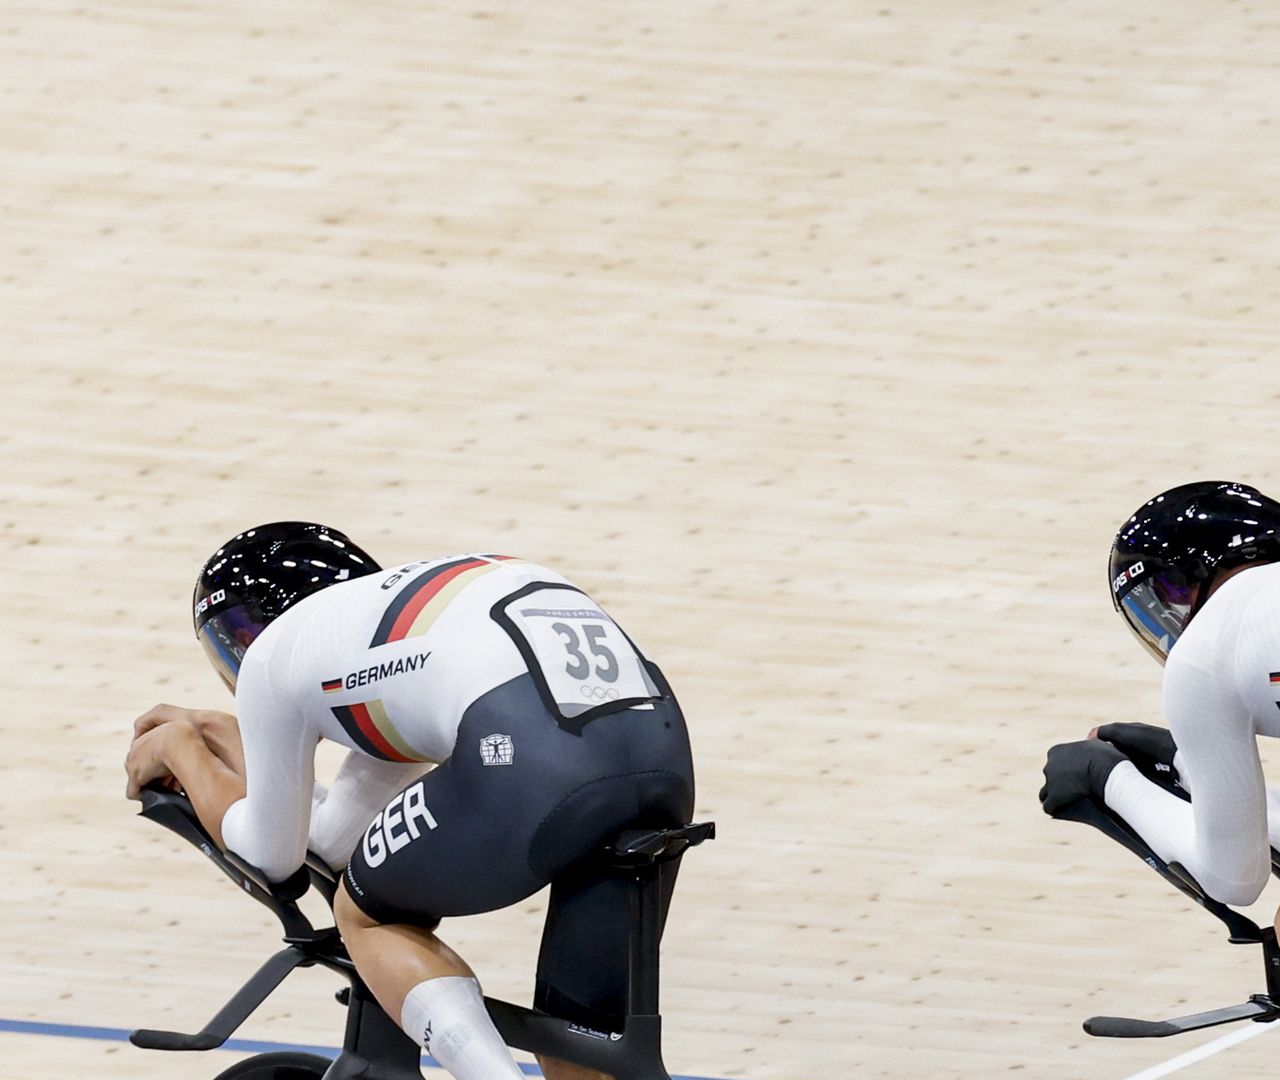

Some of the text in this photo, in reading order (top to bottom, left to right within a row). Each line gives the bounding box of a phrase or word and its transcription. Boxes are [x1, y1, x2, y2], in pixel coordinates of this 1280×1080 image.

[345, 651, 433, 690] GERMANY
[552, 622, 620, 684] 35
[363, 781, 439, 868] GER
